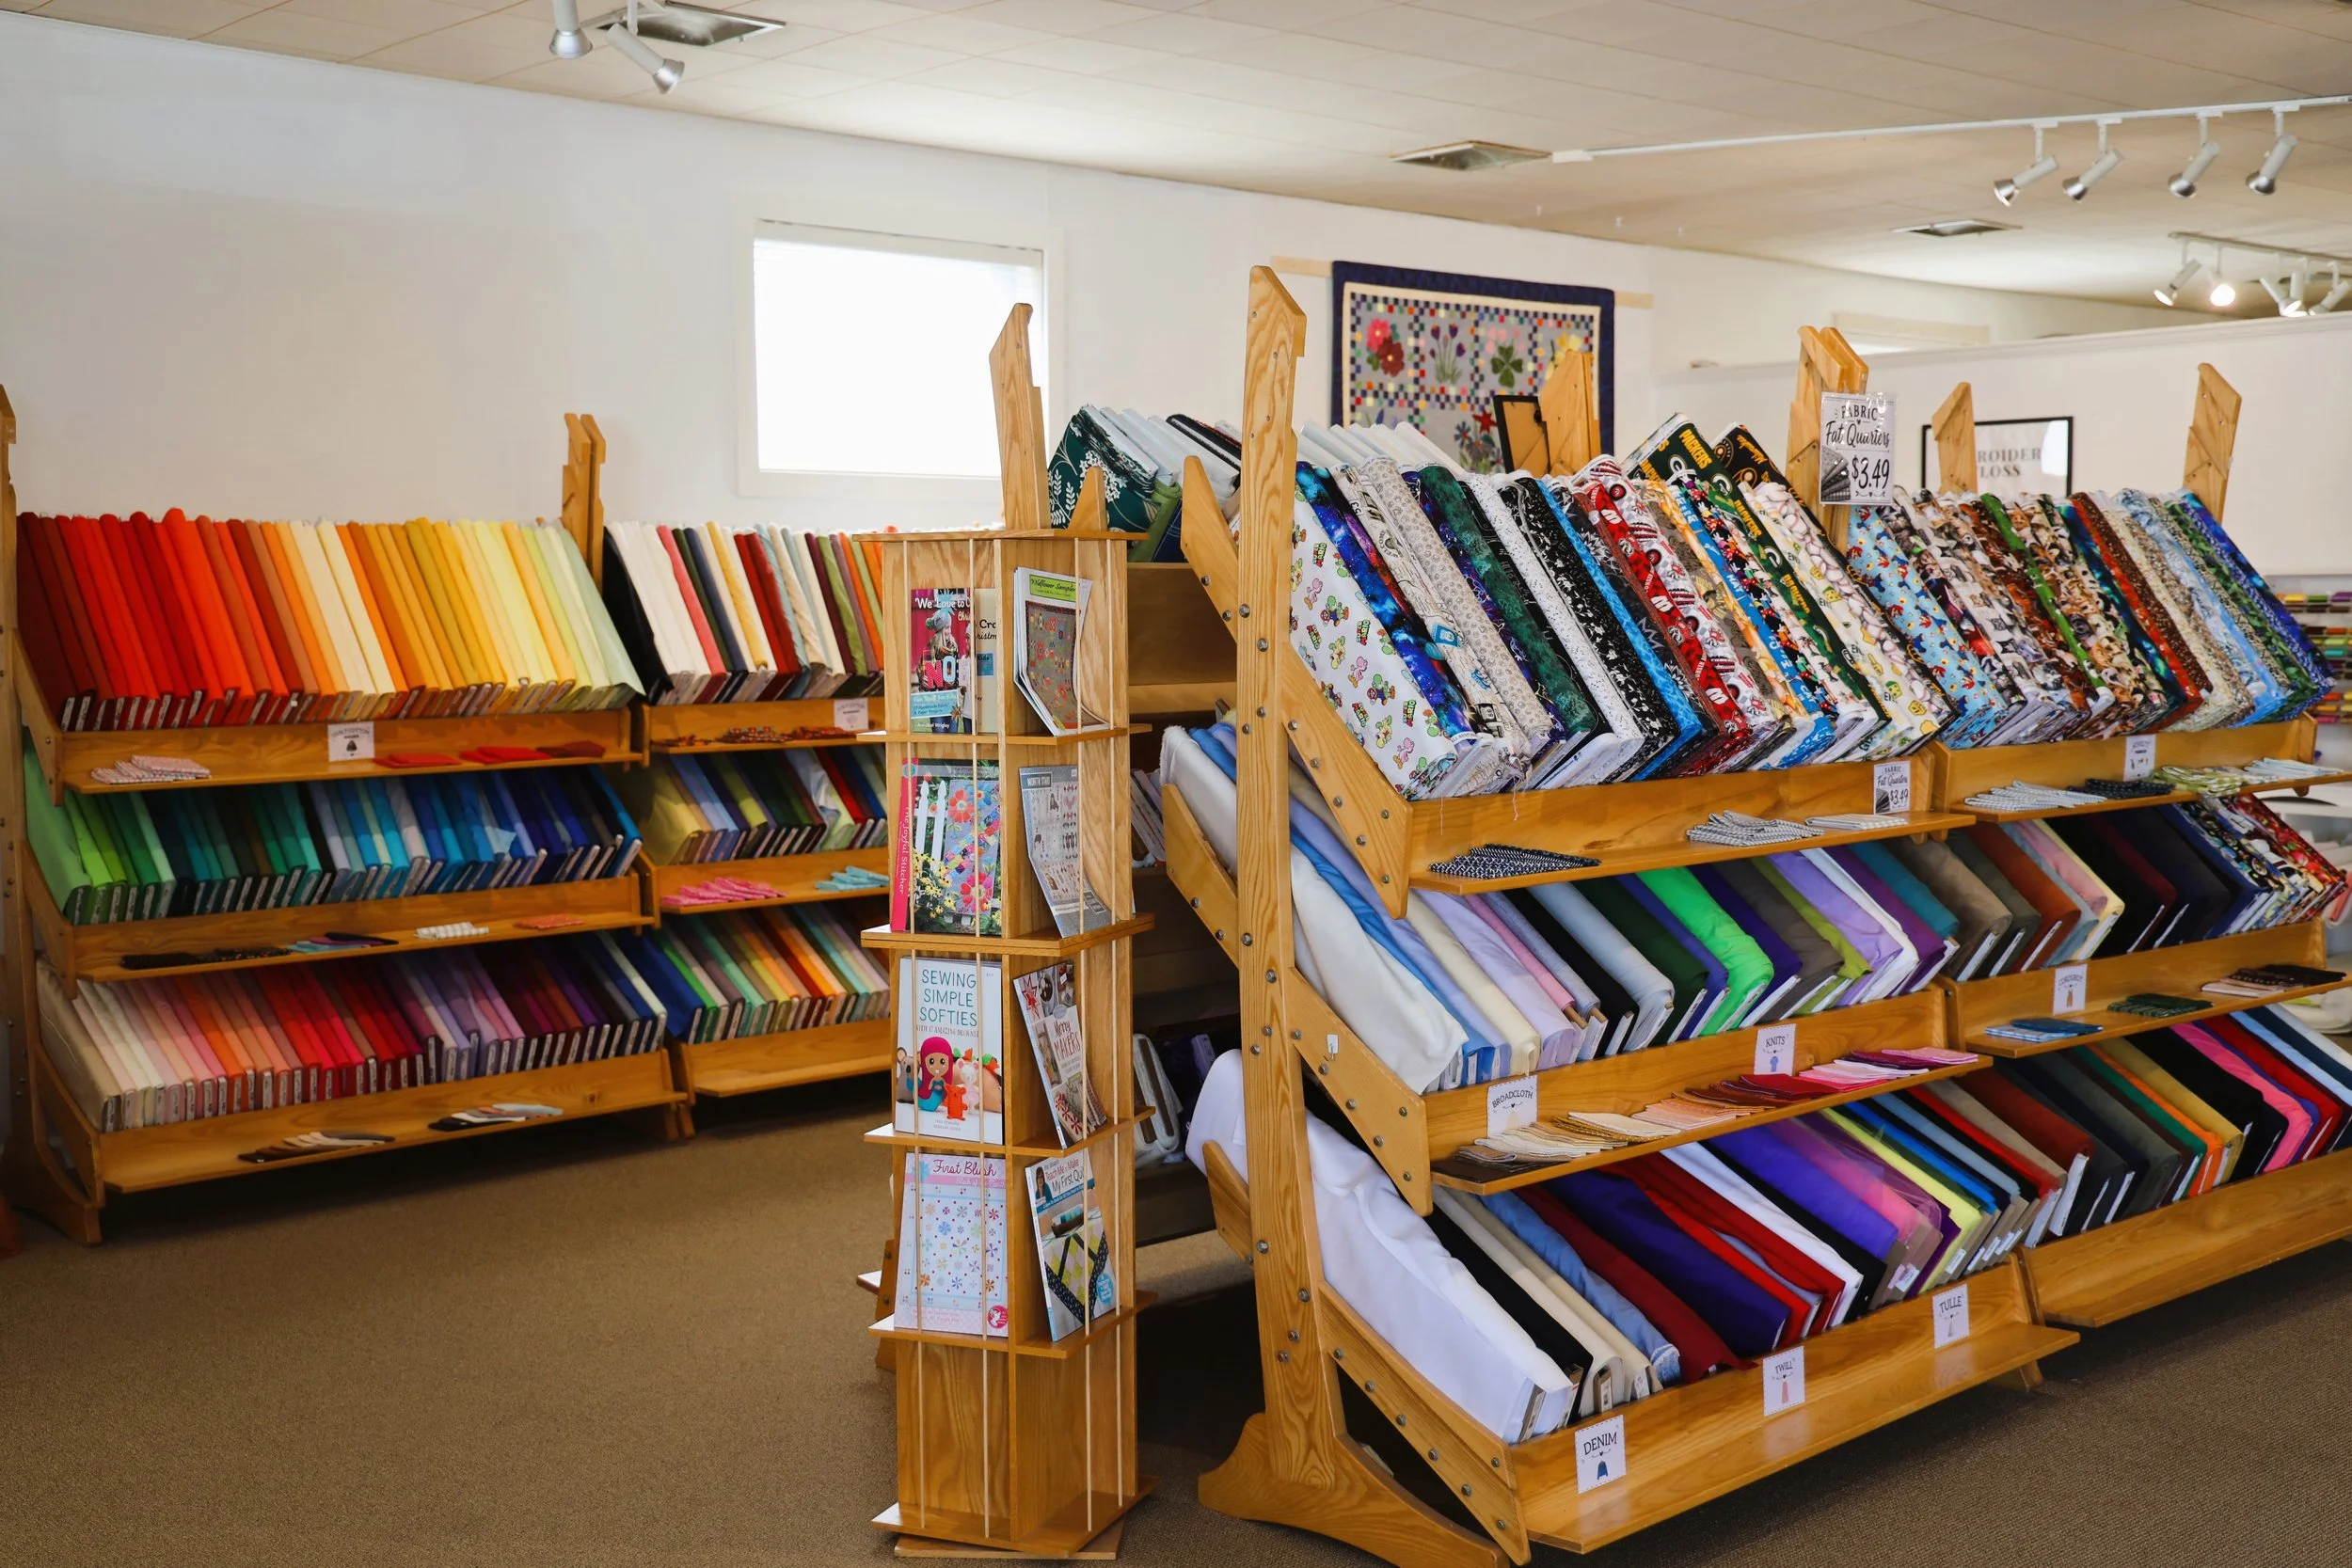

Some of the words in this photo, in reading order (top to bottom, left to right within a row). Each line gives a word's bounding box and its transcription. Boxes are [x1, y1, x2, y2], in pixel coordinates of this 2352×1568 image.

[1841, 404, 1878, 420] FABRIC
[1826, 420, 1845, 445] Fat
[1847, 423, 1890, 448] Quarters
[1678, 428, 1713, 469] PACKERS
[1978, 447, 2042, 463] ROIDER
[1851, 455, 1890, 489] $3.49
[1979, 464, 2021, 479] LOSS
[1725, 574, 1744, 593] HAT
[914, 597, 933, 609] We
[933, 598, 956, 610] Love
[957, 598, 965, 608] to
[1877, 775, 1887, 787] Fat
[1887, 774, 1908, 786] Quarters
[1890, 788, 1909, 805] $3.49
[901, 823, 910, 854] Joyful
[899, 856, 909, 895] Stitcher
[922, 969, 977, 989] SEWING
[924, 988, 975, 1007] SIMPLE
[919, 1006, 977, 1027] SOFTIES
[1054, 1032, 1081, 1061] MAKERS
[1766, 1036, 1786, 1048] KNITS
[1492, 1089, 1534, 1109] BROADCLOTH
[932, 1159, 961, 1175] First
[1068, 1158, 1079, 1169] Make
[1052, 1180, 1061, 1194] My
[1060, 1174, 1073, 1186] First
[1939, 1295, 1962, 1313] TULLE
[1583, 1432, 1617, 1455] DENIM
